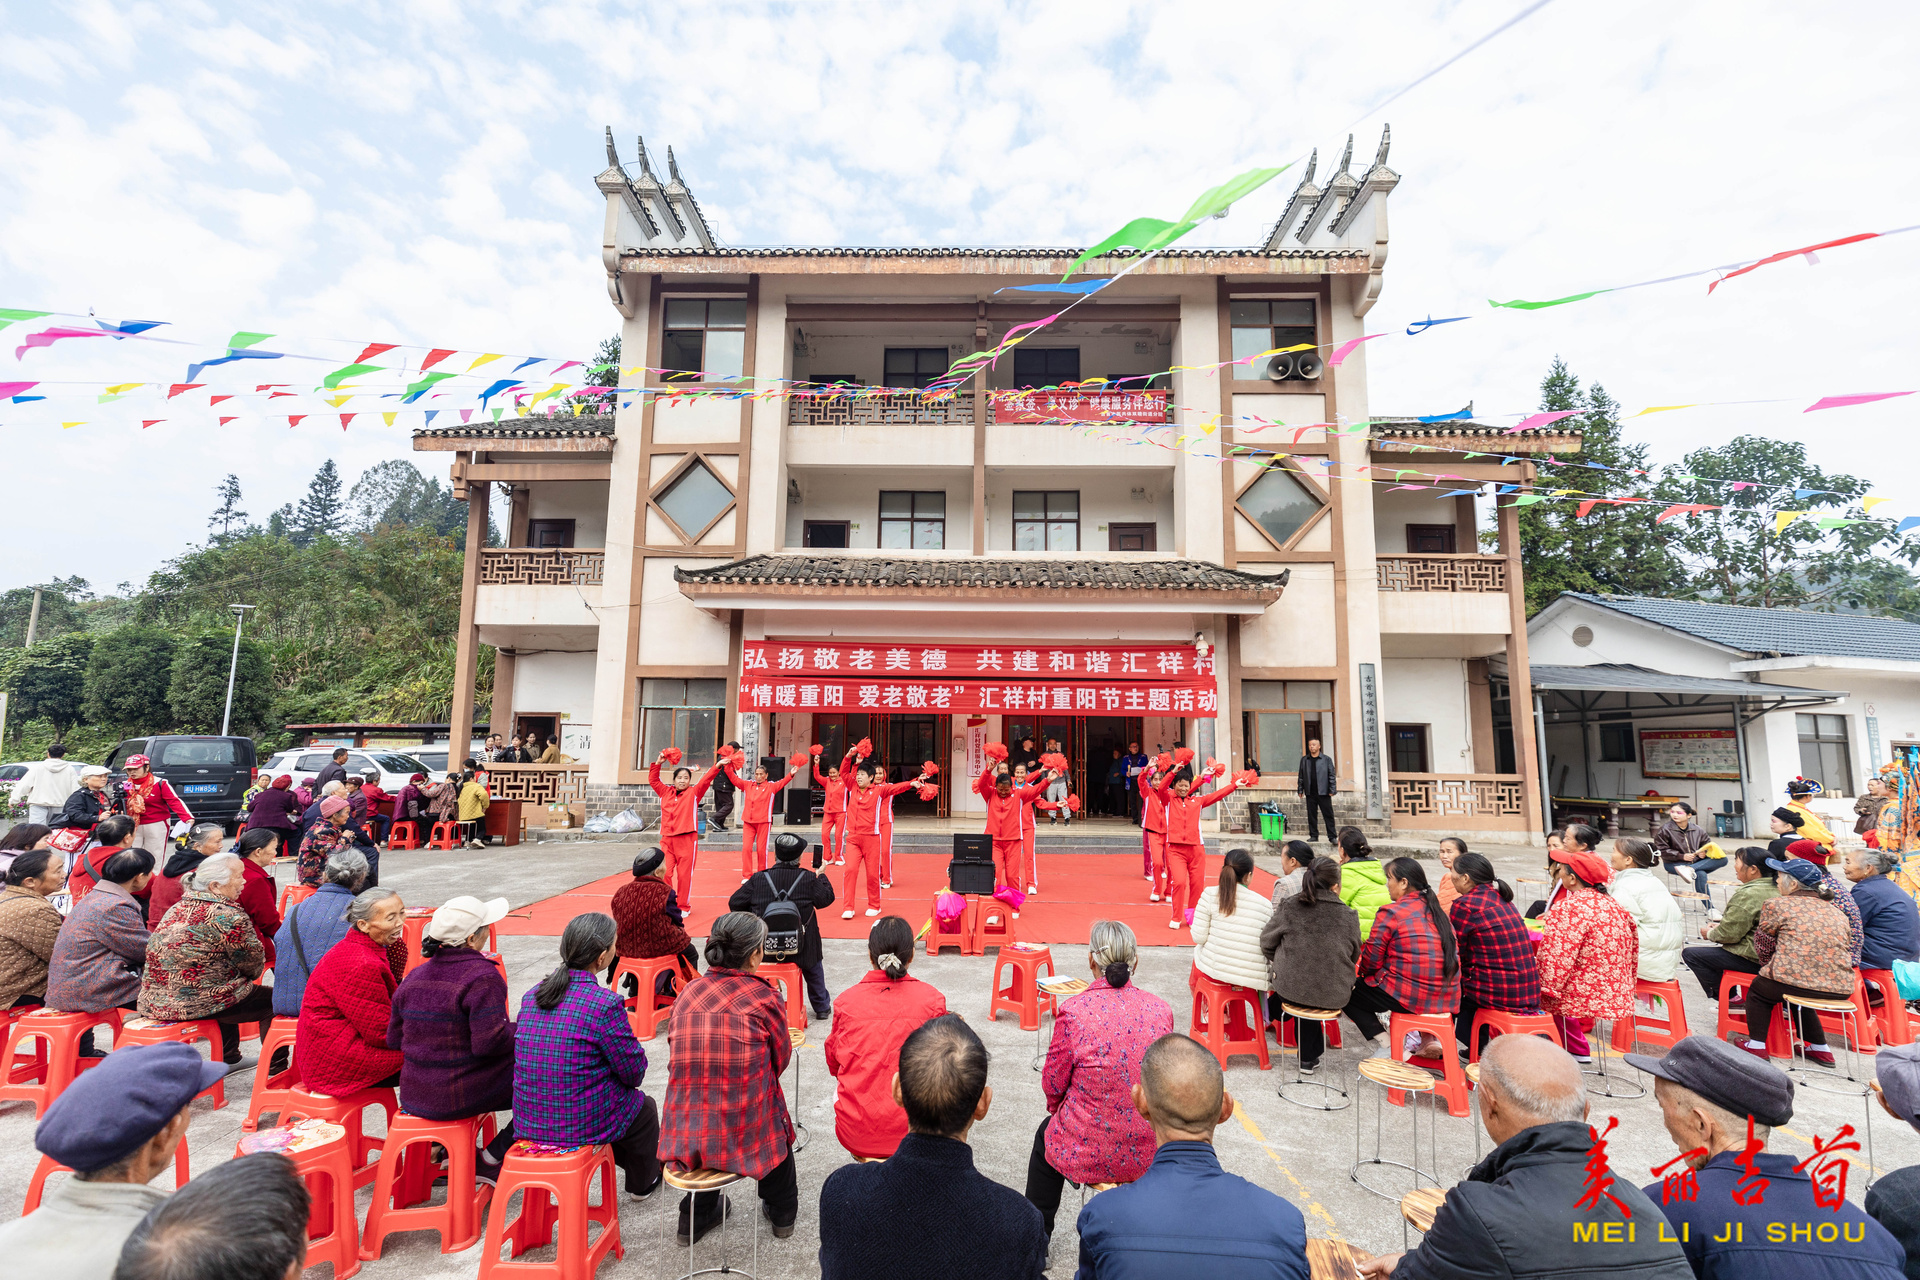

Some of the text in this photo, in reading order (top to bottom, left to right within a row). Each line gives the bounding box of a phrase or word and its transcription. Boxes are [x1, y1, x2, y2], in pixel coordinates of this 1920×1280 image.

[744, 648, 1216, 676] 弘扬敬老美德 共建和谐汇祥村
[740, 684, 844, 707] “情暖重阳
[979, 686, 1218, 712] 汇祥村重阳节主题活动
